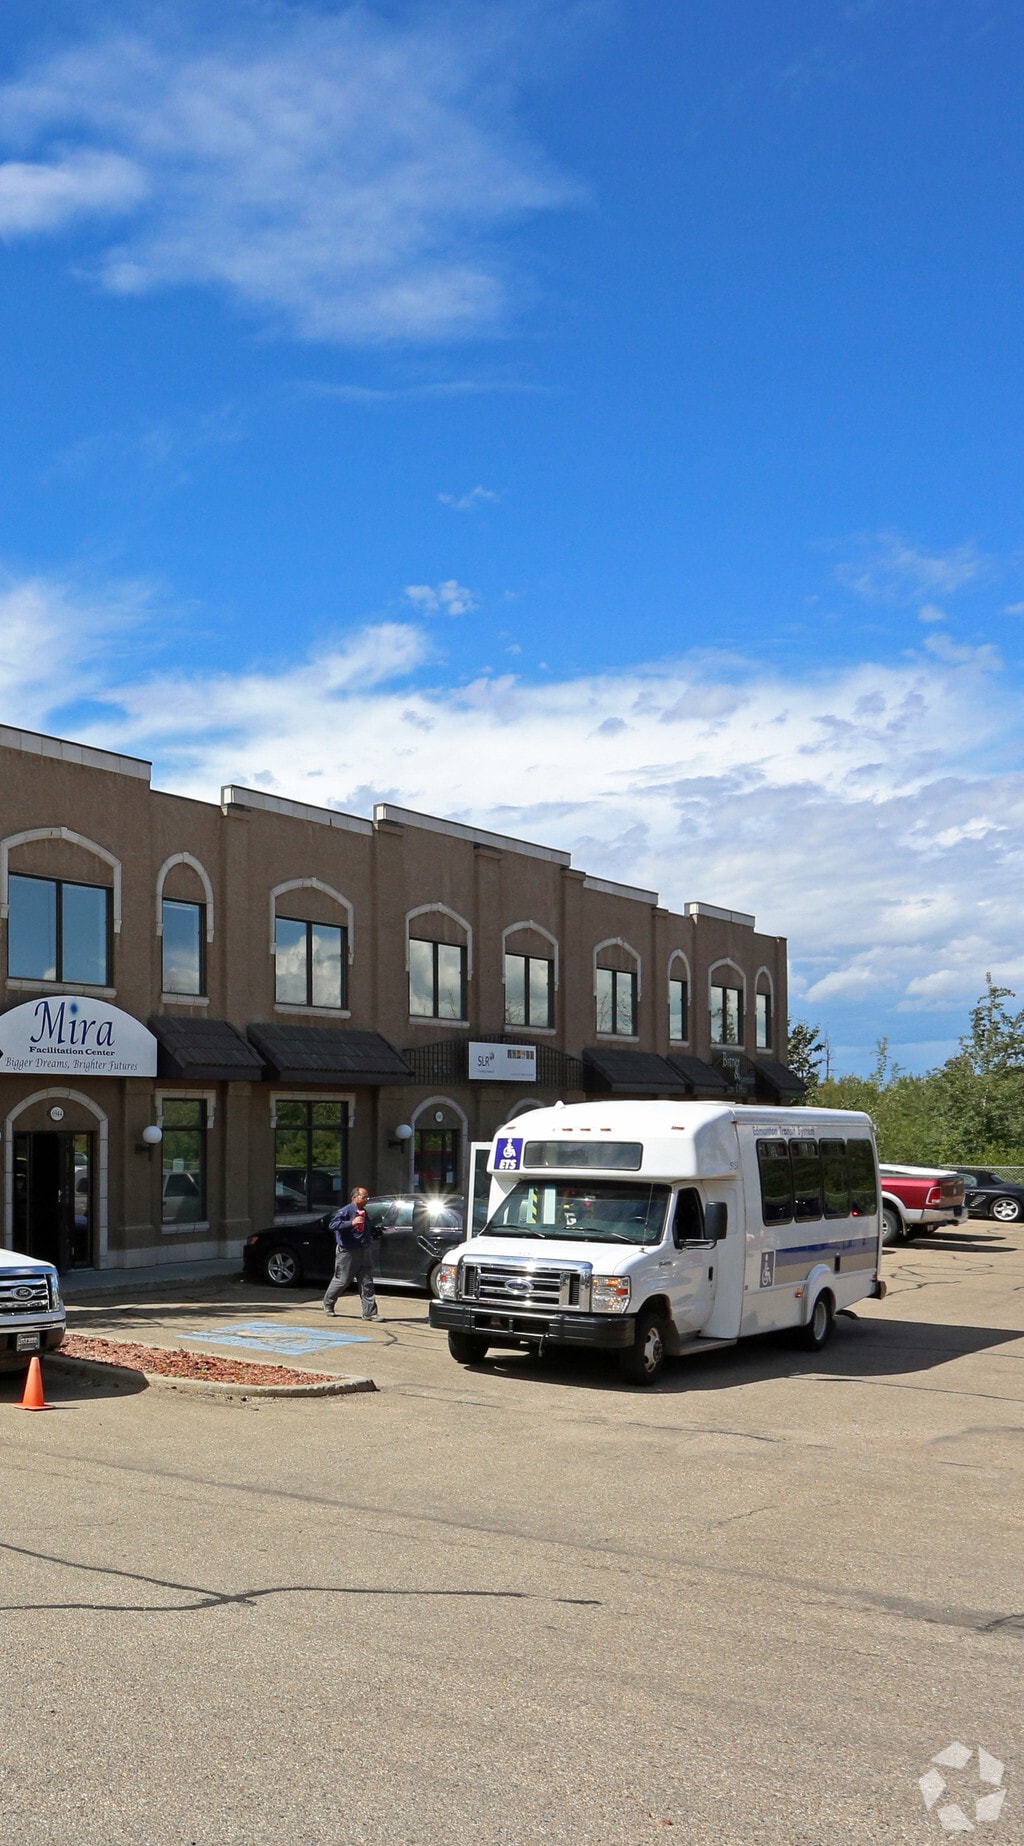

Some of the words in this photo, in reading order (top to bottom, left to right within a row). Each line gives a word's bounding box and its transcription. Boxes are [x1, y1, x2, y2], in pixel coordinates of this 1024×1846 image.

[30, 1001, 115, 1047] Mira
[29, 1046, 83, 1055] Facilitation
[85, 1048, 115, 1056] Center
[5, 1057, 33, 1070] Bigger
[35, 1058, 70, 1069] Dreams,
[73, 1059, 107, 1072] Brighter
[108, 1060, 138, 1071] Futures
[478, 1056, 490, 1066] SLR
[752, 1126, 778, 1136] Edmonton
[779, 1126, 796, 1136] Transit
[797, 1126, 815, 1137] System
[499, 1159, 517, 1169] ETS
